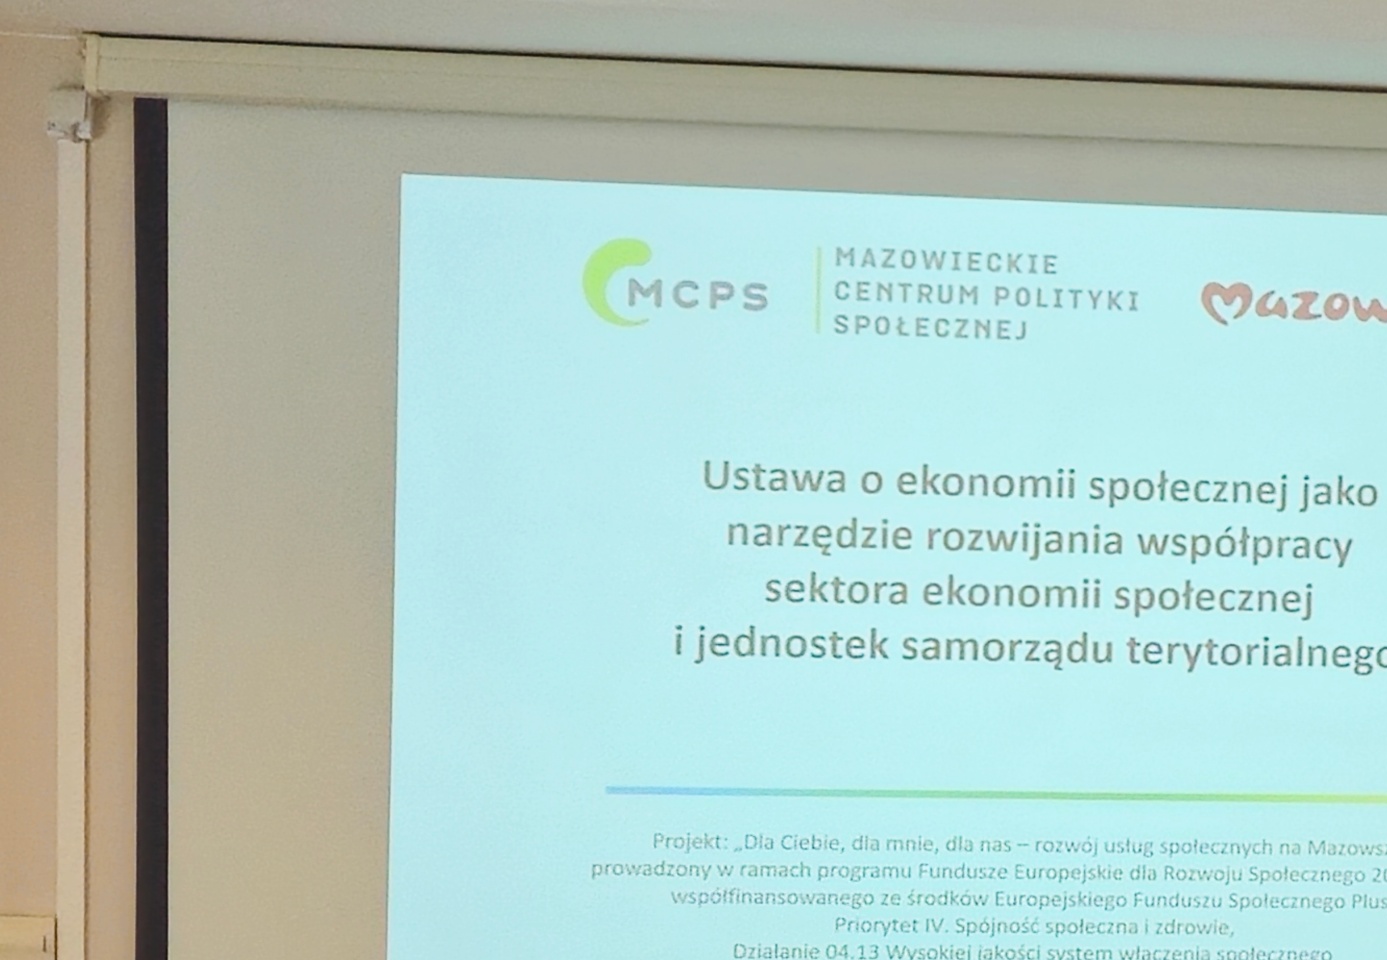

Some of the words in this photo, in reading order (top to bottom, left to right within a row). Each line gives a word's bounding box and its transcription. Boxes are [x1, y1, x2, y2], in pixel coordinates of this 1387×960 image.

[834, 246, 1058, 275] MAZOWIECKIE
[628, 278, 768, 312] MCPS
[834, 280, 979, 305] CENTRUM
[994, 286, 1138, 312] POLITYKI
[834, 314, 1027, 340] SPOŁECZNEJ
[704, 460, 846, 493] Ustawa
[861, 471, 883, 494] o
[897, 463, 1076, 499] ekonomii
[1089, 470, 1288, 513] społecznej
[1299, 474, 1378, 513] jako
[728, 517, 912, 556] narzędzie
[928, 522, 1123, 561] rozwijania
[1137, 526, 1353, 568] współpracy
[765, 571, 908, 605] sektora
[923, 574, 1101, 609] ekonomii
[1114, 579, 1313, 621] społecznej
[675, 624, 683, 656] i
[694, 625, 889, 664] jednostek
[902, 631, 1113, 671] samorządu
[653, 832, 728, 854] Projekt:
[781, 834, 845, 853] Ciebie,
[852, 835, 880, 851] dla
[886, 836, 939, 854] mnie,
[945, 836, 973, 852] dla
[980, 840, 1011, 852] nas
[1035, 836, 1098, 857] rozwój
[1105, 838, 1154, 858] usług
[1160, 838, 1272, 859] społecznych
[1279, 842, 1300, 855] na
[591, 861, 711, 880] prowadzony
[717, 864, 734, 877] w
[740, 862, 811, 878] ramach
[817, 864, 911, 882] programu
[918, 863, 1007, 879] Fundusze
[1015, 864, 1123, 884] Europejskie
[1130, 865, 1157, 881] dla
[1164, 865, 1242, 886] Rozwoju
[1249, 866, 1365, 886] Społecznego
[671, 887, 874, 909] współfinansowanego
[881, 893, 901, 906] ze
[907, 889, 989, 906] środków
[995, 891, 1127, 912] Europejskiego
[1134, 892, 1222, 909] Funduszu
[1228, 893, 1345, 913] Społecznego
[835, 917, 919, 937] Priorytet
[925, 918, 949, 934] IV.
[955, 917, 1039, 938] Spójność
[1046, 918, 1138, 938] społeczna
[1154, 918, 1235, 938] zdrowie,
[733, 943, 820, 960] Działanie
[825, 944, 879, 960] 04.13
